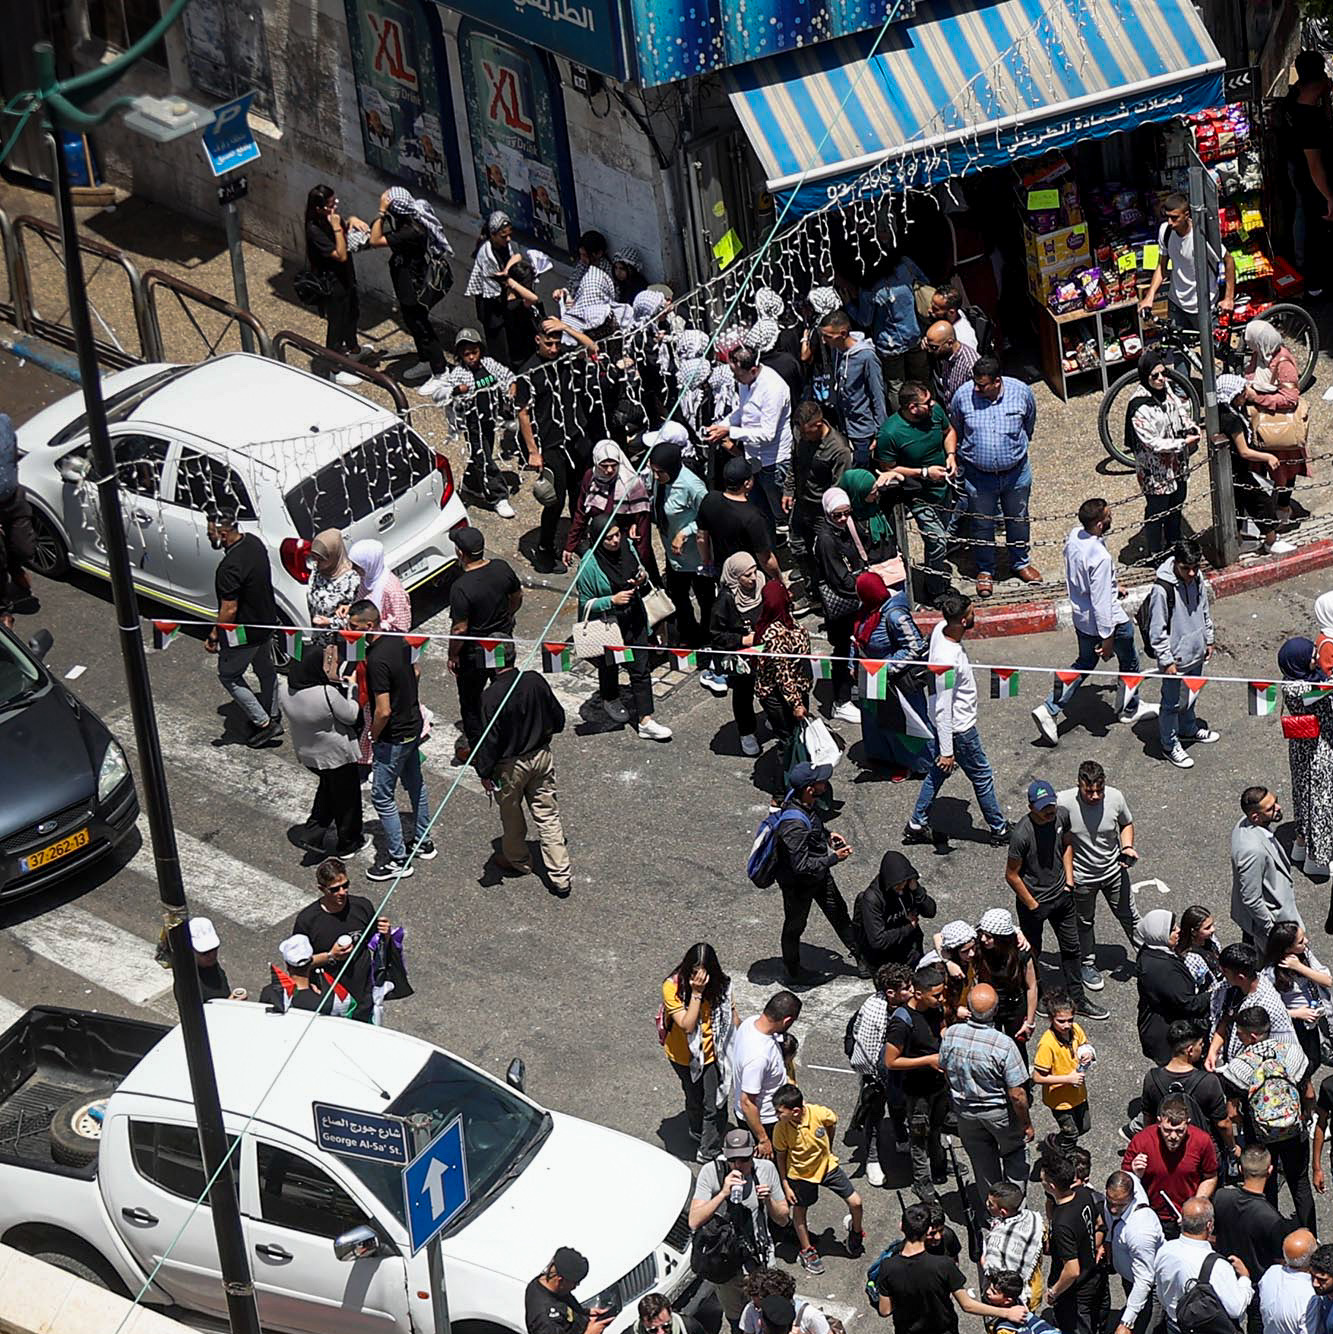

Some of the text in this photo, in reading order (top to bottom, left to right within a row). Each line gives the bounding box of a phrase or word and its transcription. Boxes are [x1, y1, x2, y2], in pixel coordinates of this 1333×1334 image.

[368, 13, 416, 84] XL
[483, 62, 532, 134] XL
[321, 1115, 401, 1139] شارع جورج الصاع
[323, 1132, 402, 1156] George Al-Sa' St.
